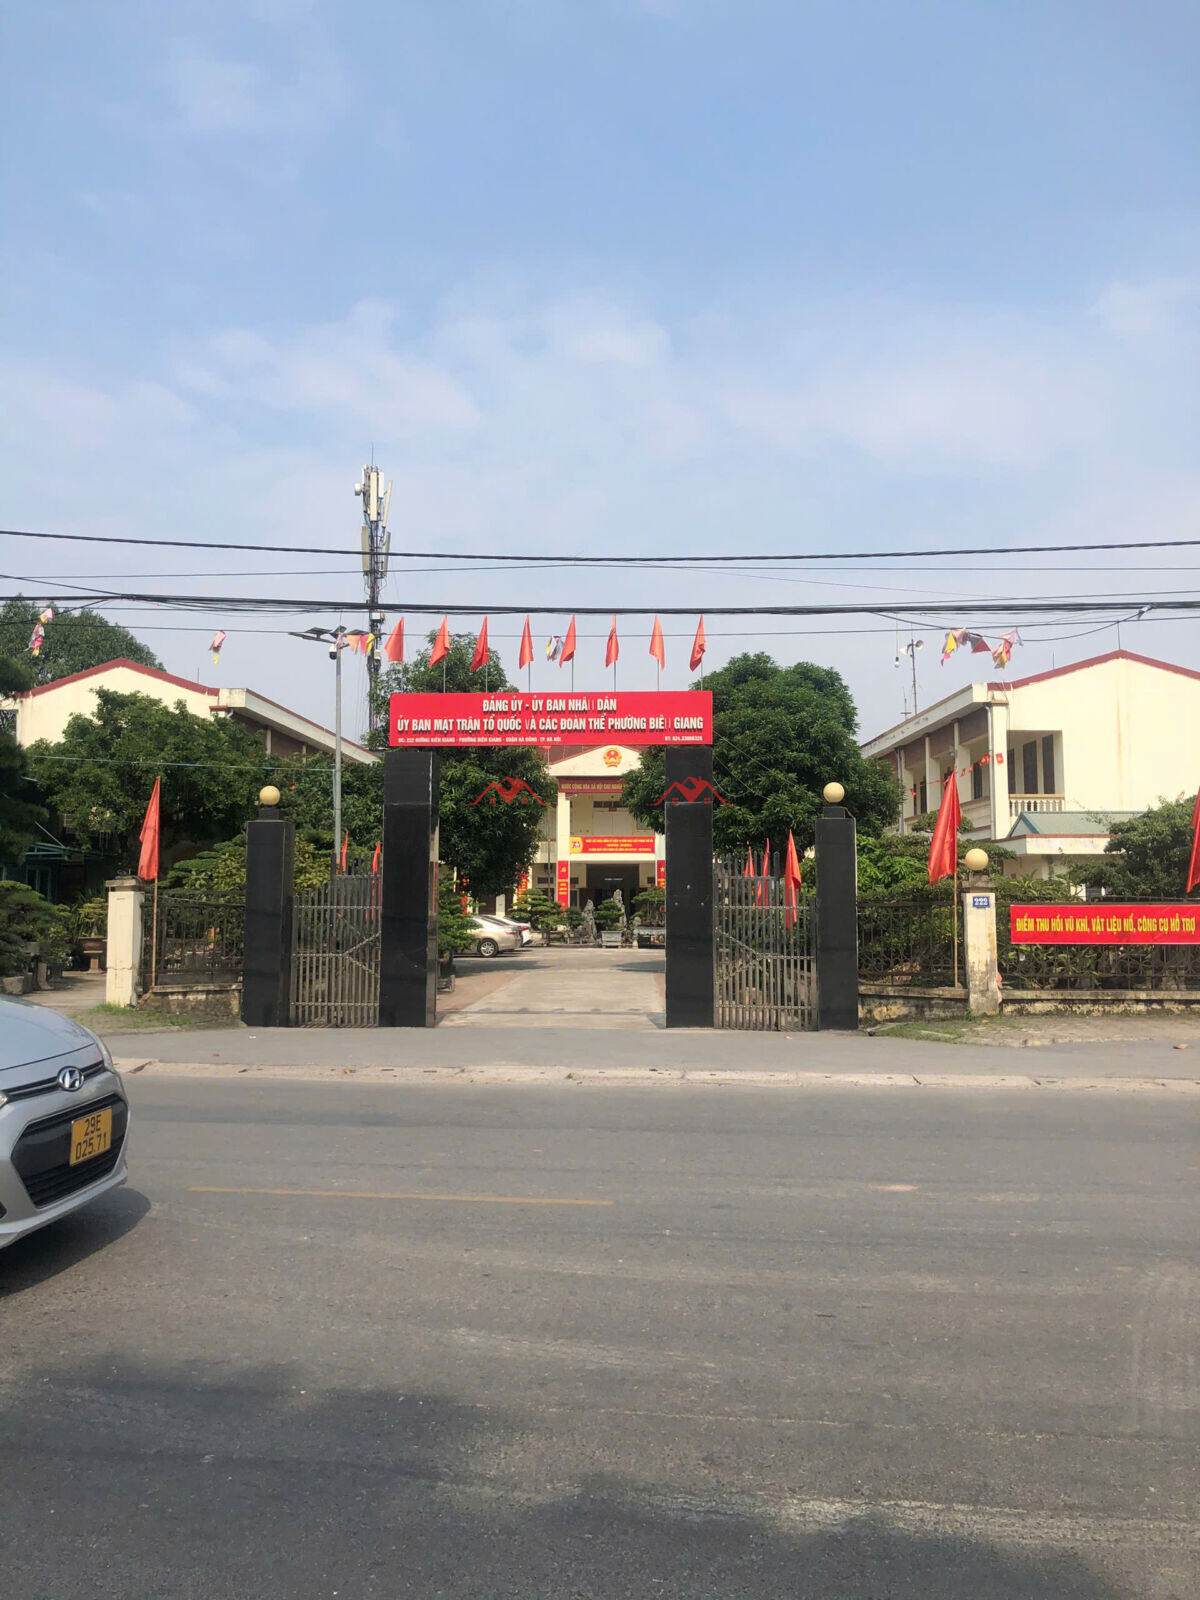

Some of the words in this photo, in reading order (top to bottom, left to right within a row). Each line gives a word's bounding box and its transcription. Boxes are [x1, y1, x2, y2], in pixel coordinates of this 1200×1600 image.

[483, 695, 508, 712] ĐẢNG
[511, 695, 523, 712] ỦY
[532, 695, 543, 712] ỦY
[546, 699, 566, 711] BAN
[568, 696, 595, 711] NHÂ
[397, 715, 410, 731] ỦY
[412, 718, 431, 731] BAN
[456, 716, 481, 733] TRẬN
[497, 713, 522, 731] QUỐC
[539, 715, 558, 730] CÁC
[560, 715, 586, 730] ĐOÀN
[588, 712, 606, 730] THỂ
[608, 713, 647, 730] PHƯỜNG
[650, 715, 671, 729] BIÊ
[674, 716, 704, 729] GIANG
[974, 897, 988, 906] 222
[1016, 913, 1034, 932] ĐIỂM
[1036, 918, 1049, 932] THU
[1064, 915, 1074, 932] VŨ
[1091, 915, 1104, 935] VẬT
[1106, 915, 1122, 935] LIỆU
[1137, 915, 1157, 932] CÔNG
[1159, 917, 1168, 935] CỤ
[1181, 916, 1196, 935] TRỢ
[84, 1114, 102, 1136] 29E
[75, 1131, 107, 1161] 025.71
